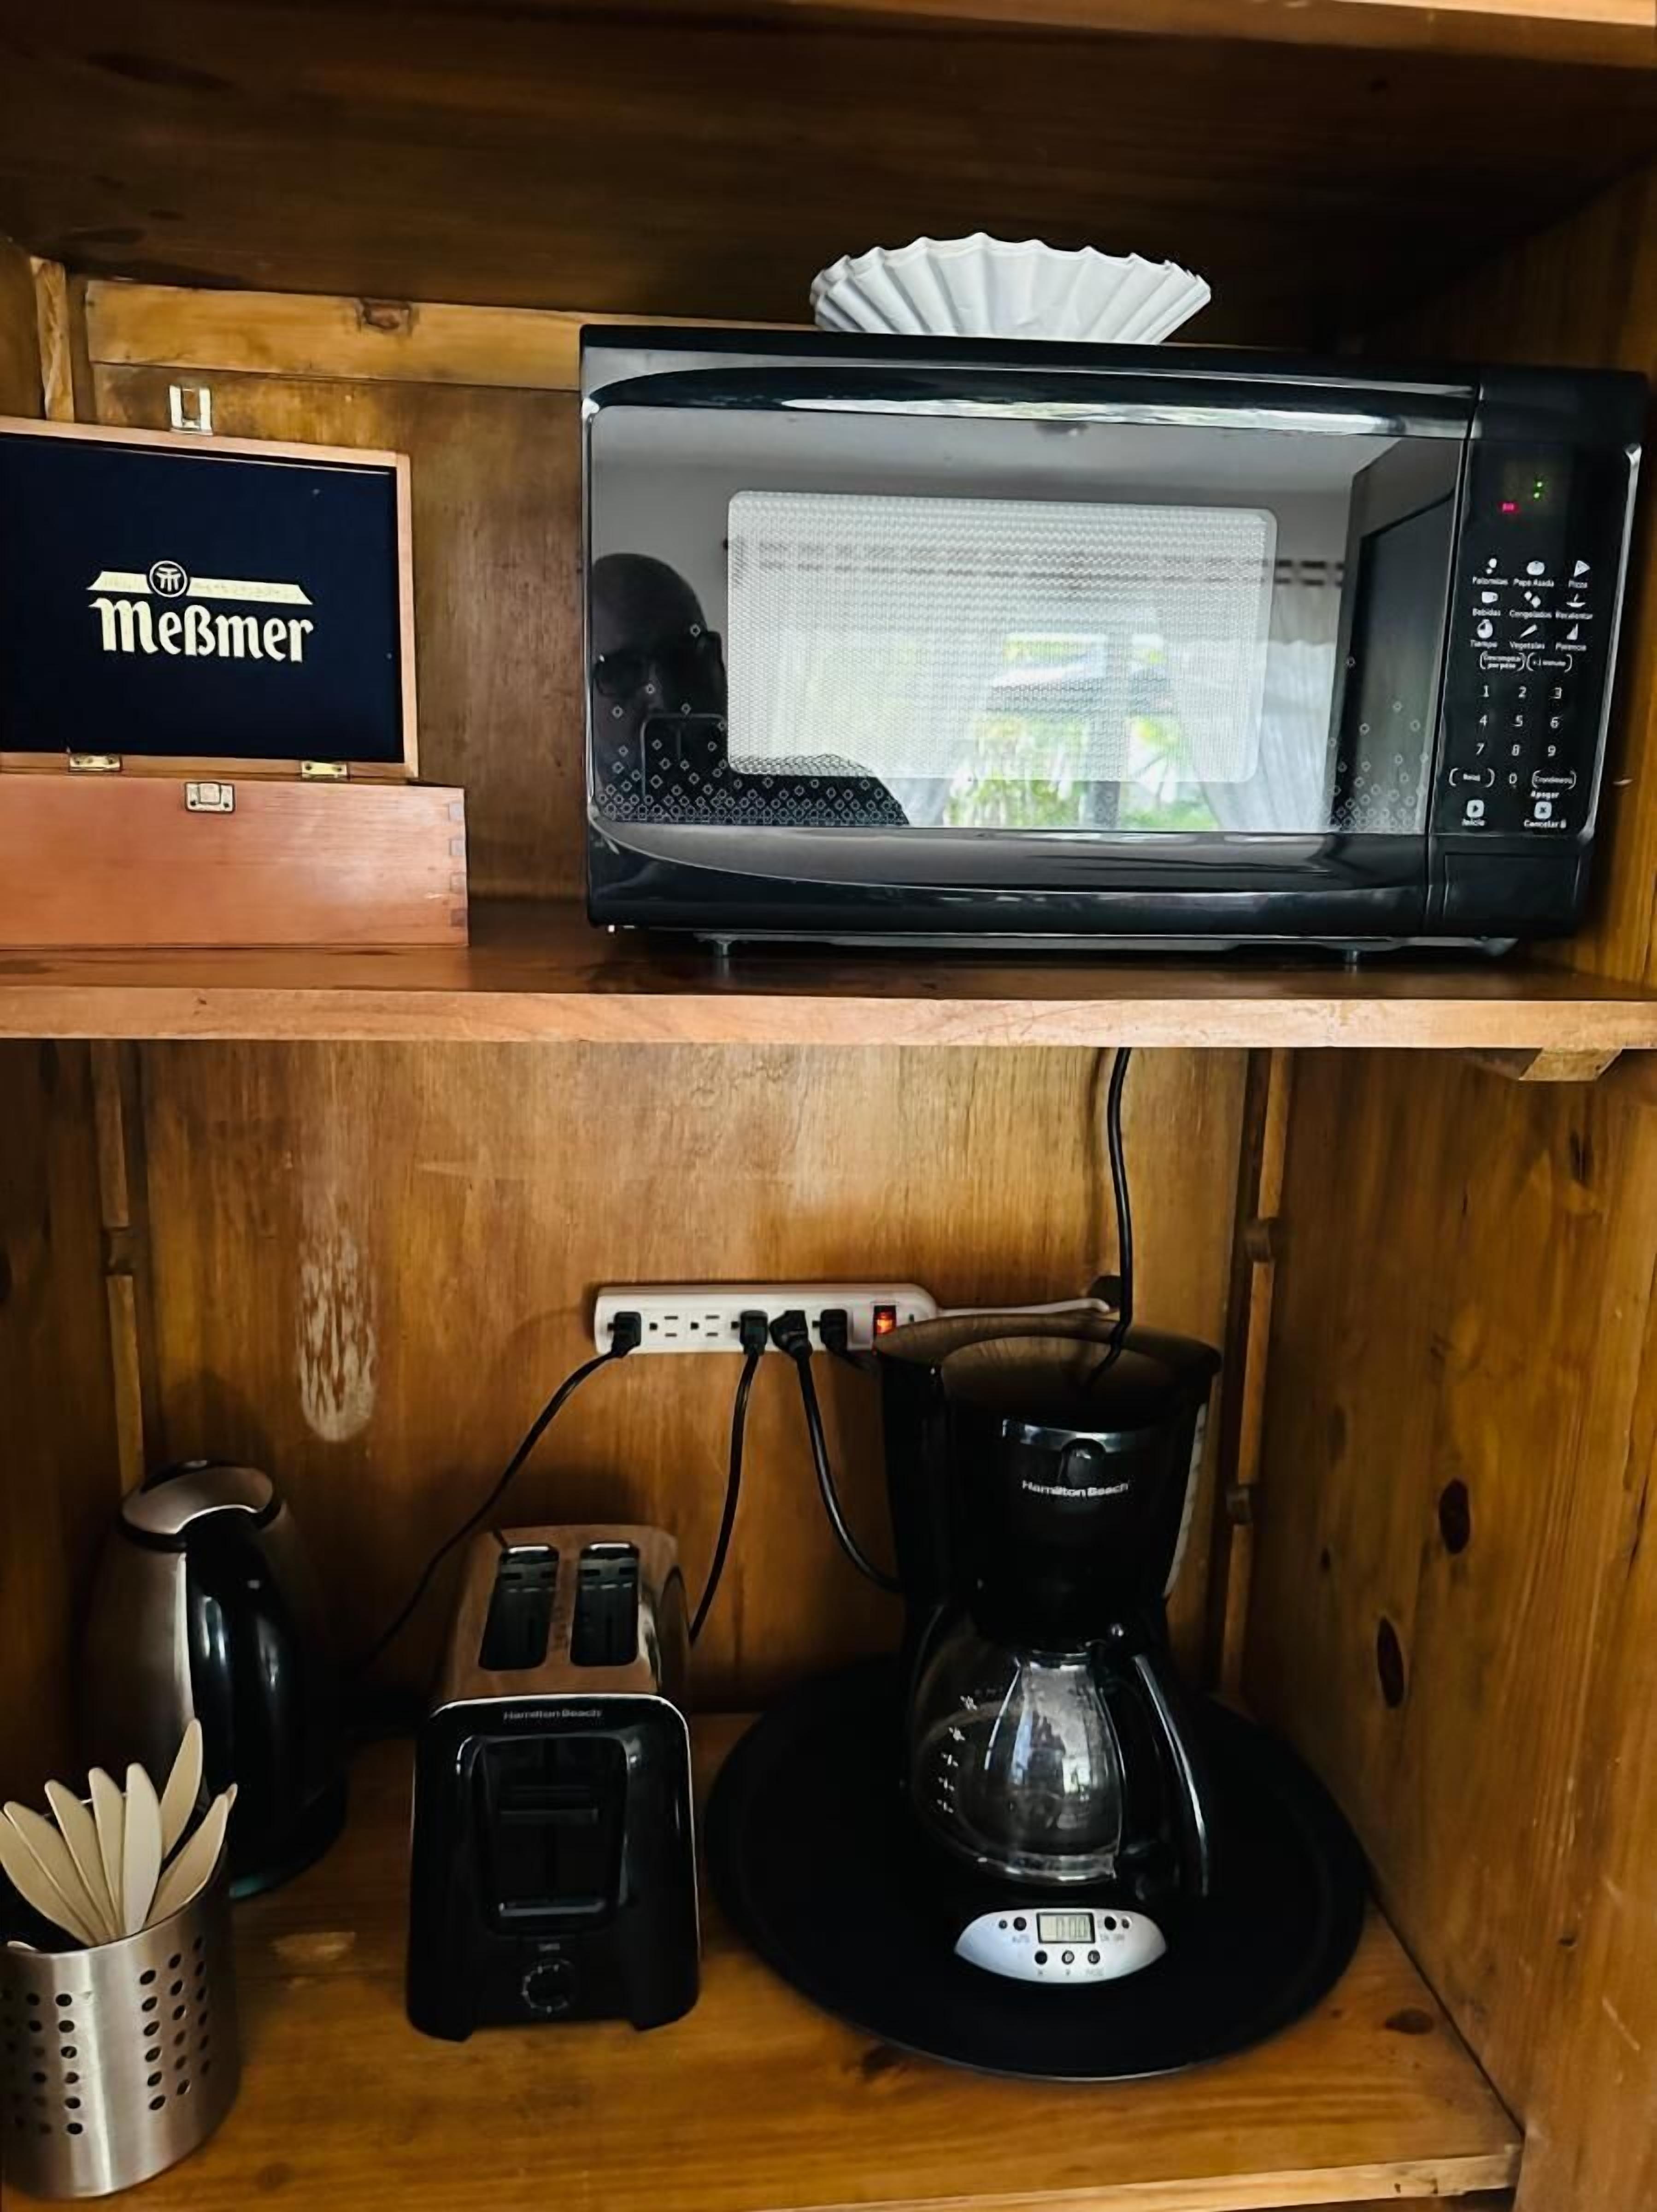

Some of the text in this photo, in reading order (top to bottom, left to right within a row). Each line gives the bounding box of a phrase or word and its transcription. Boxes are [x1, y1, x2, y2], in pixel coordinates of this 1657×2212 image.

[88, 597, 314, 663] Meßmer
[1484, 685, 1489, 697] 1
[1519, 686, 1527, 698] 2
[1554, 687, 1562, 699] 3
[1480, 715, 1487, 726] 4
[1515, 715, 1523, 726] 5
[1550, 717, 1559, 728] 6
[1476, 743, 1484, 755] 7
[1511, 744, 1520, 756] 8
[1548, 745, 1556, 757] 9
[1509, 773, 1517, 784] 0
[1022, 1480, 1128, 1497] Hamilton Beach
[504, 1710, 560, 1719] Hamilton
